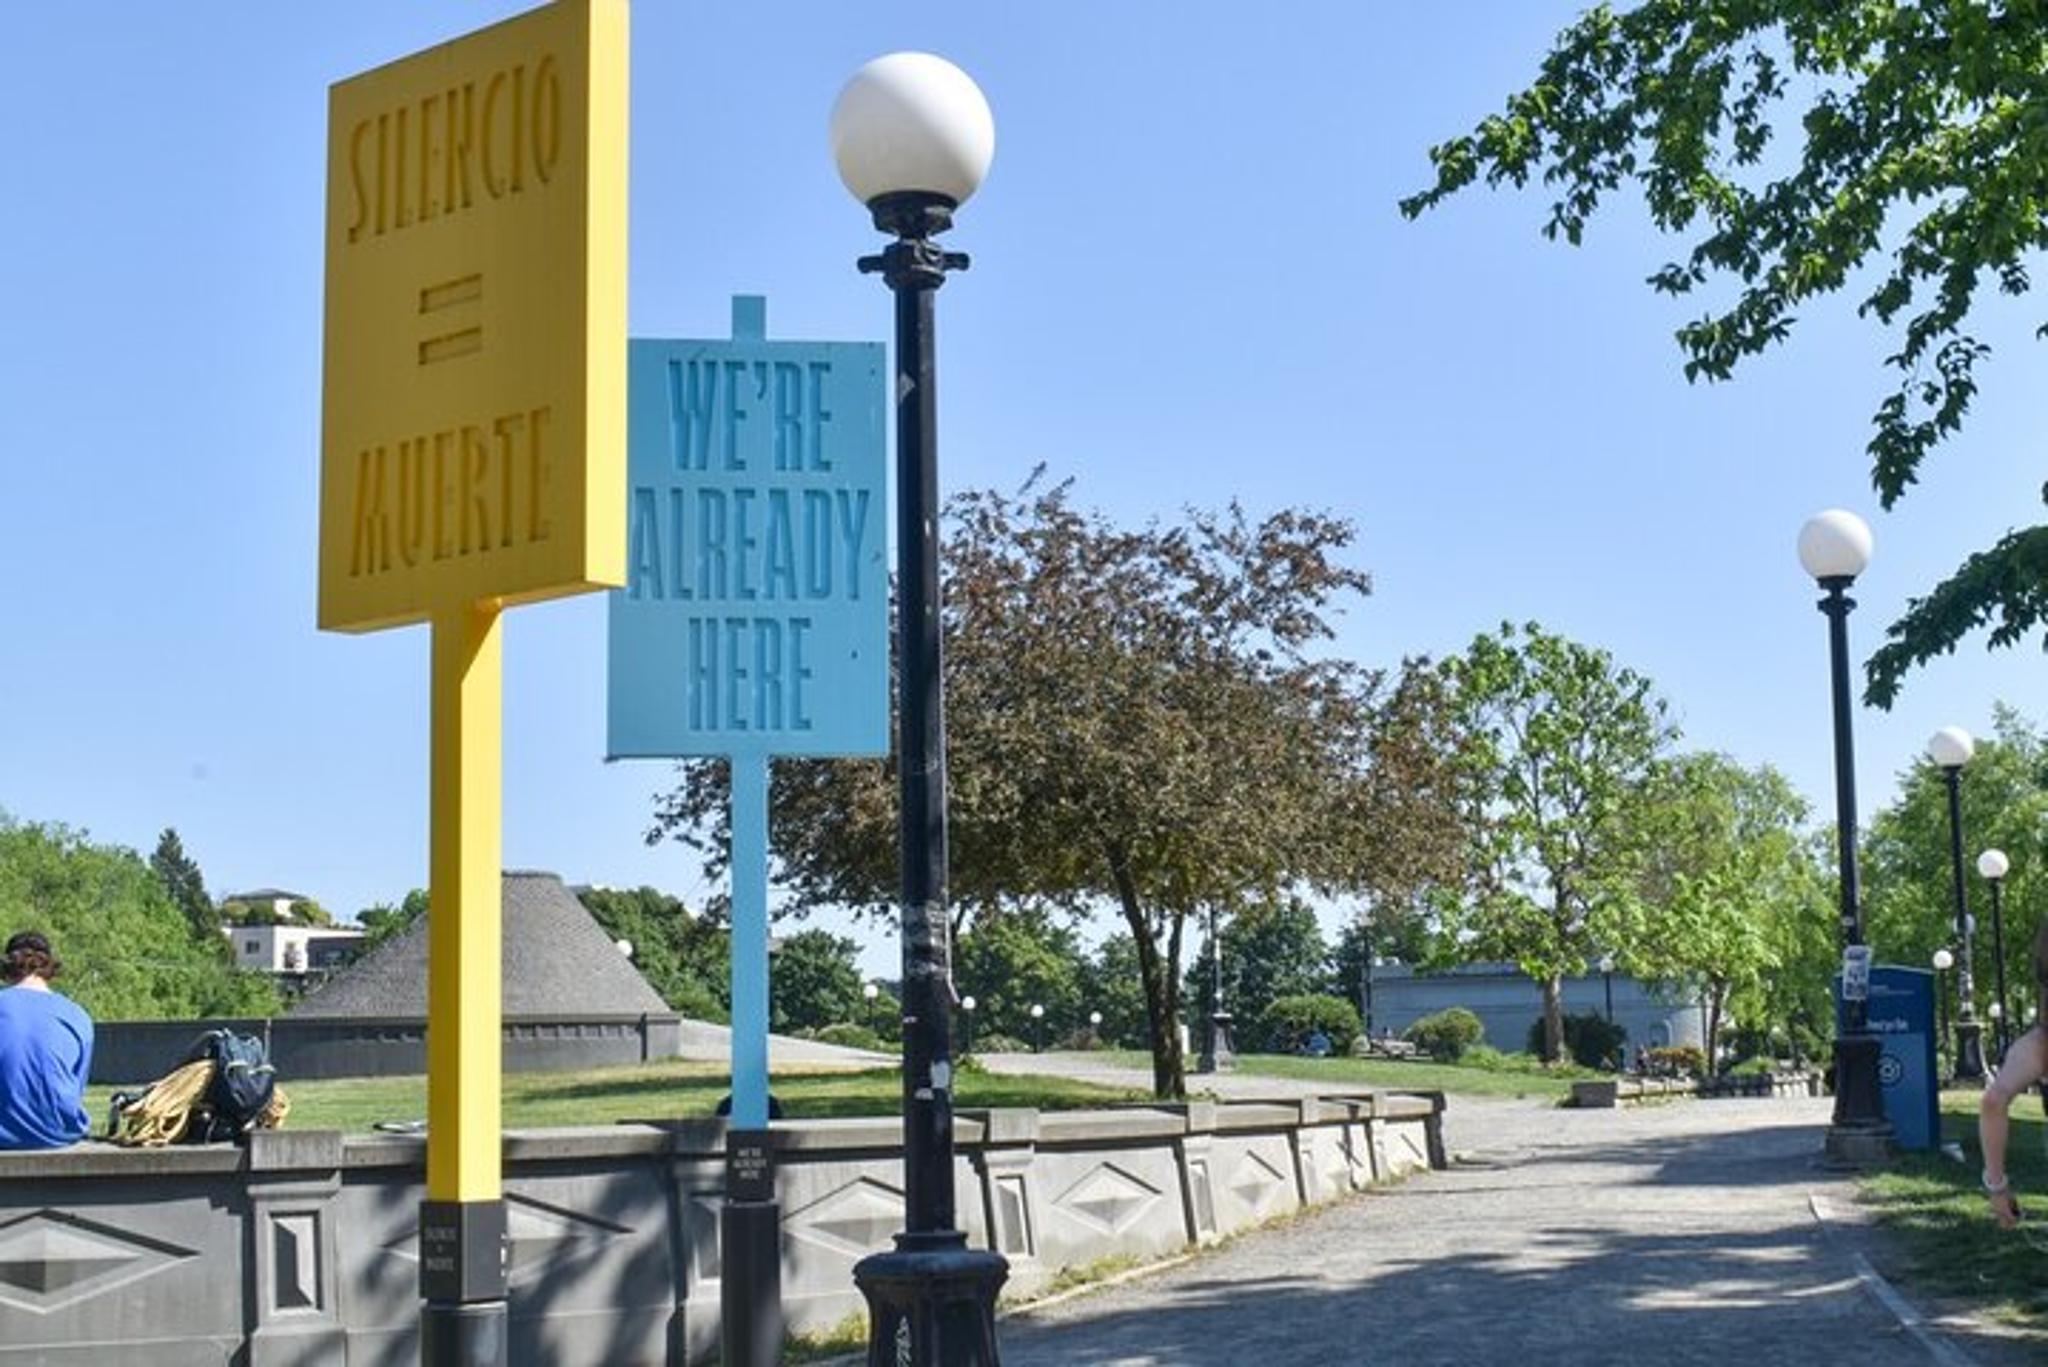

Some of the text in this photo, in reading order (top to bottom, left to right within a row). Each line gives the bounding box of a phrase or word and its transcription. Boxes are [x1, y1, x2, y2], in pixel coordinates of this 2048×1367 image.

[348, 54, 560, 243] SILENCIO
[668, 360, 833, 472] WE'RE
[350, 405, 551, 577] MUERTE
[629, 487, 870, 600] ALREADY
[688, 616, 812, 731] HERE
